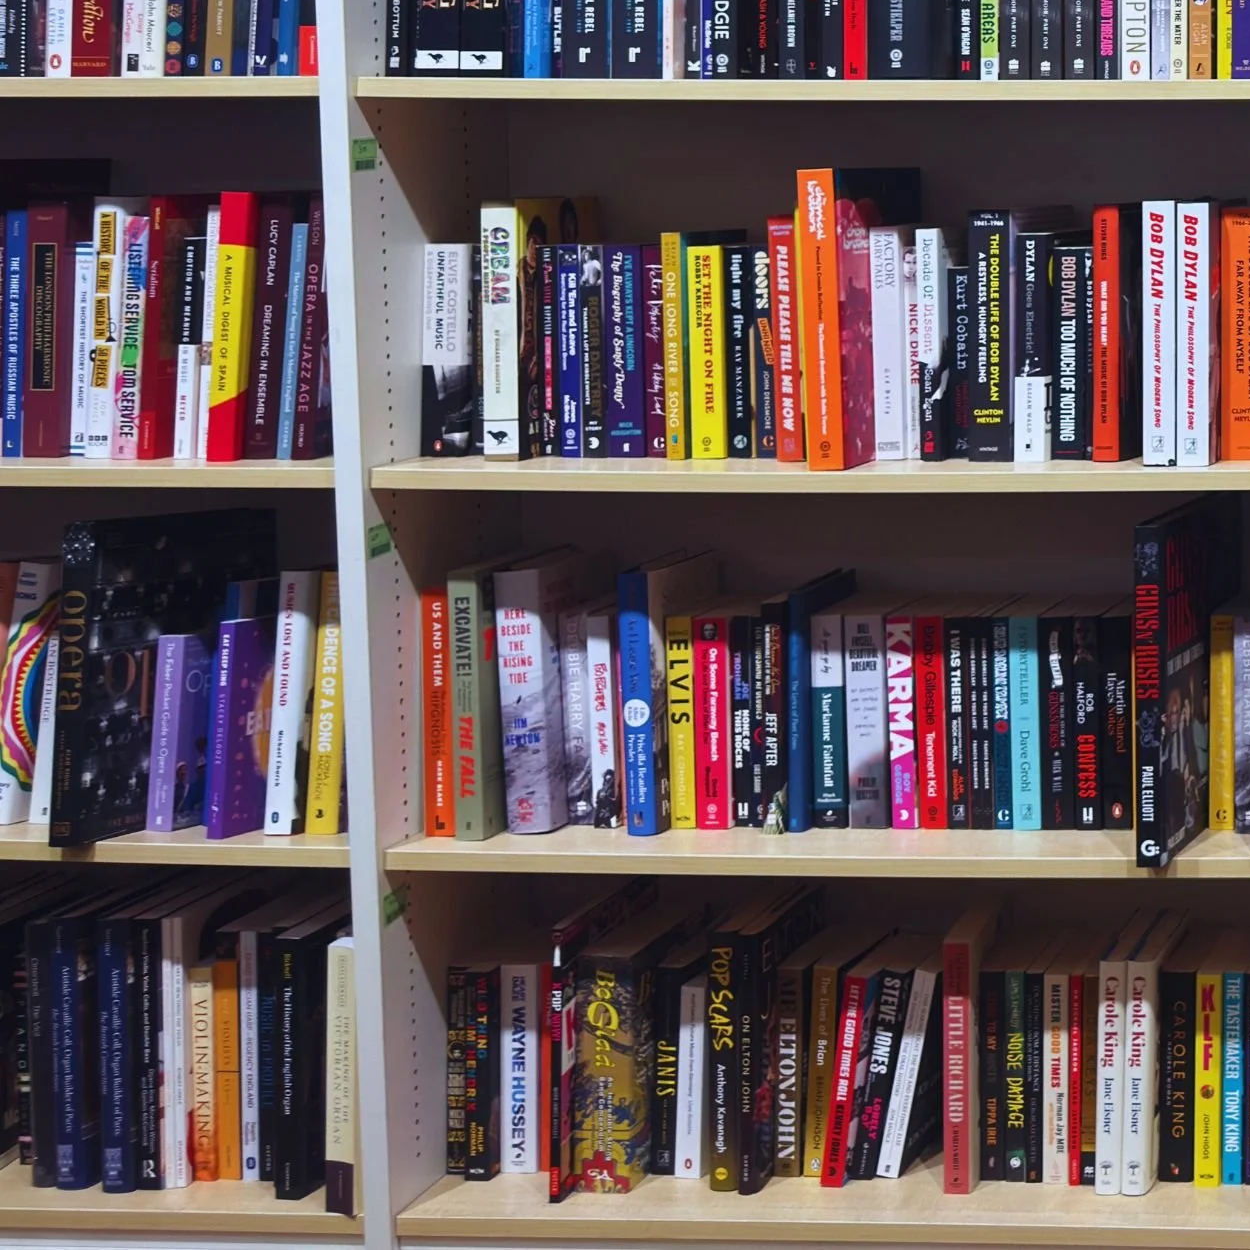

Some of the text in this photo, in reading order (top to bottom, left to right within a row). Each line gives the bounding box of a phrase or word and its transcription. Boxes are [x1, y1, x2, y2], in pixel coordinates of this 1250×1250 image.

[256, 305, 272, 424] DREAMING IN ENSEMBLE
[702, 255, 714, 413] SET THE NIGHT ON FIRE
[956, 275, 967, 369] Kurt Cobain
[1060, 256, 1076, 441] BOB DYLAN TOO MUCH OF NOTHING
[432, 603, 442, 686] US AND THEM
[454, 597, 472, 676] EXCAVATE!
[669, 640, 690, 724] ELVIS
[886, 622, 914, 760] KARMA
[1076, 682, 1085, 723] HALFORD
[1086, 693, 1094, 711] ROB
[765, 712, 778, 766] JEFF APTER
[1129, 977, 1147, 1067] Carole King
[511, 1007, 525, 1152] WAYNE HUSSEY
[716, 1064, 726, 1152] Anthony Kavanagh
[742, 1038, 750, 1112] ELTON JOHN
[1225, 1090, 1239, 1151] TONY KING
